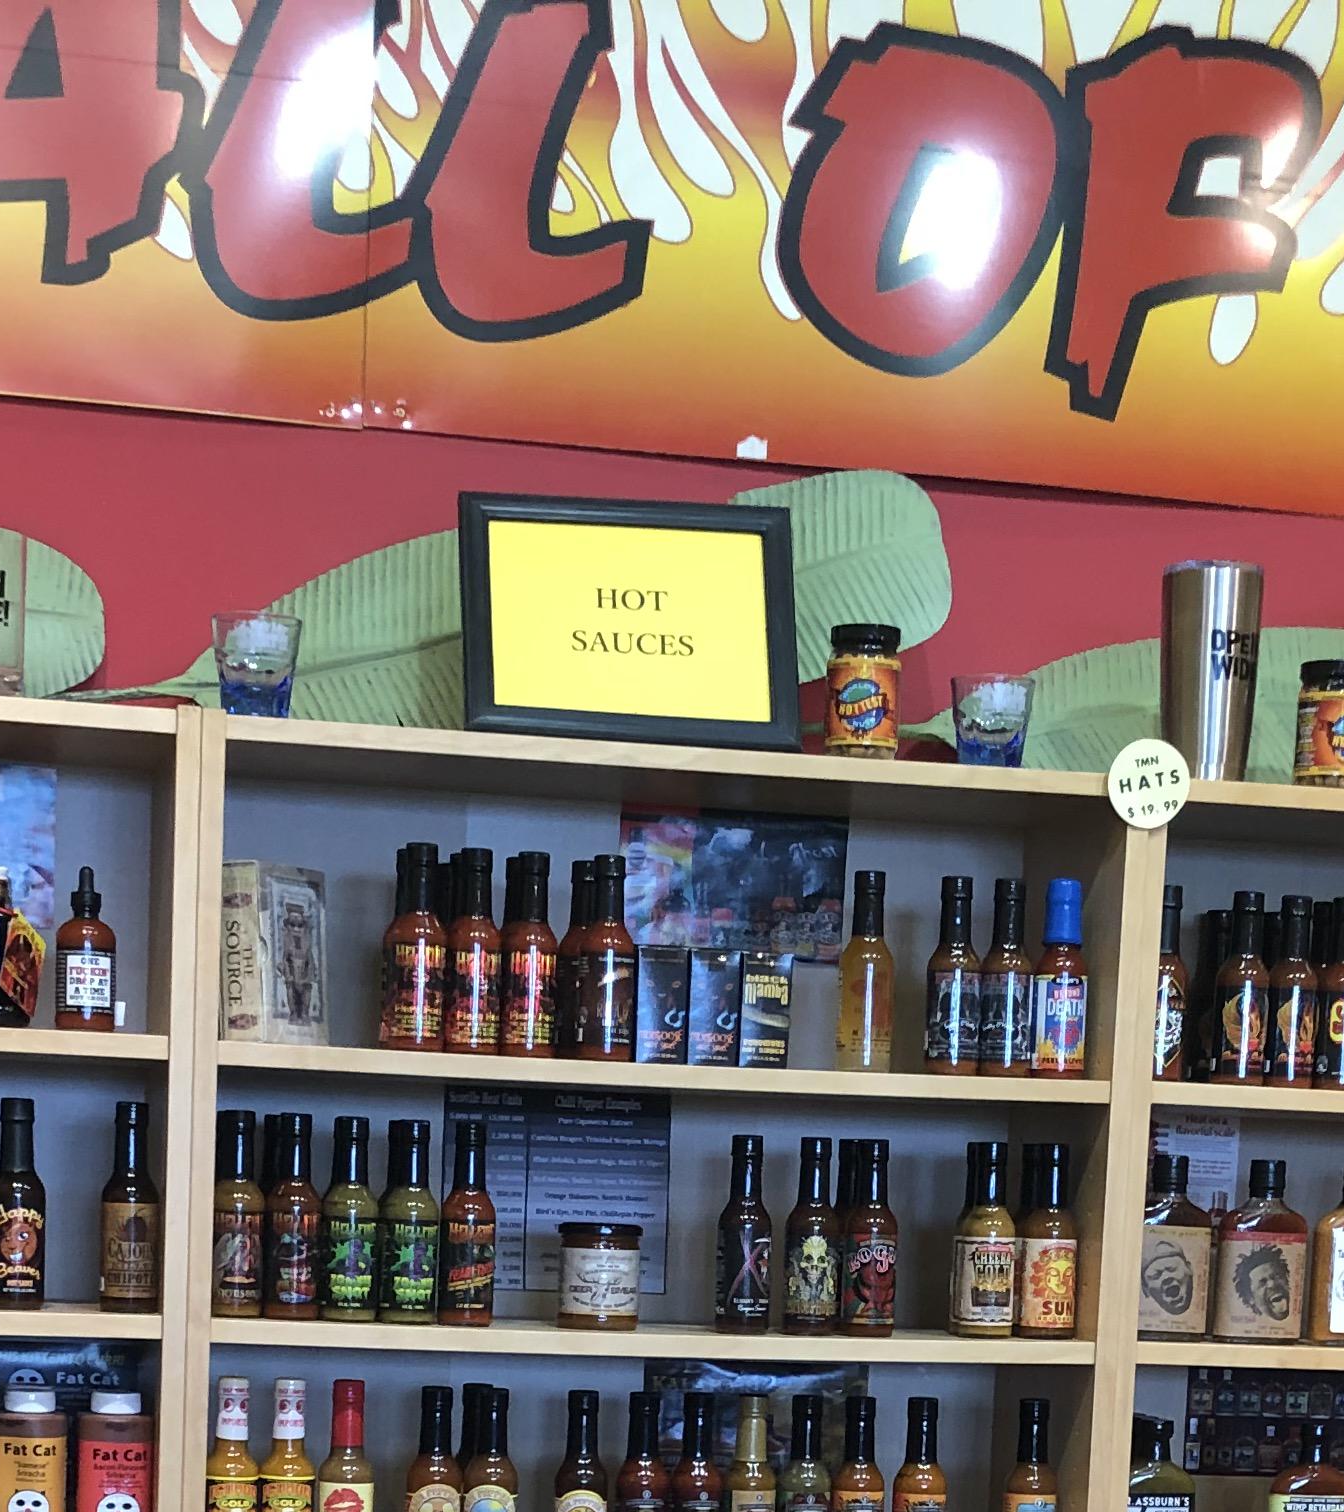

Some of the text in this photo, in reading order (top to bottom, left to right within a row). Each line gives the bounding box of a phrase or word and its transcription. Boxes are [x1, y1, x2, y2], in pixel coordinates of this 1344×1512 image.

[775, 22, 1322, 421] OF
[594, 586, 669, 611] HOT
[571, 629, 695, 658] SAUCES
[1135, 756, 1159, 768] TMN
[1119, 770, 1180, 794] HATS
[225, 919, 241, 1007] SOURCE
[243, 943, 253, 977] THE
[1046, 998, 1084, 1017] DEATH
[1041, 1299, 1074, 1317] SUN
[56, 1372, 120, 1386] Fat Cat
[4, 1444, 56, 1456] Fat Cat
[93, 1449, 147, 1461] Fat Cat
[1286, 1502, 1306, 1512] WIMP
